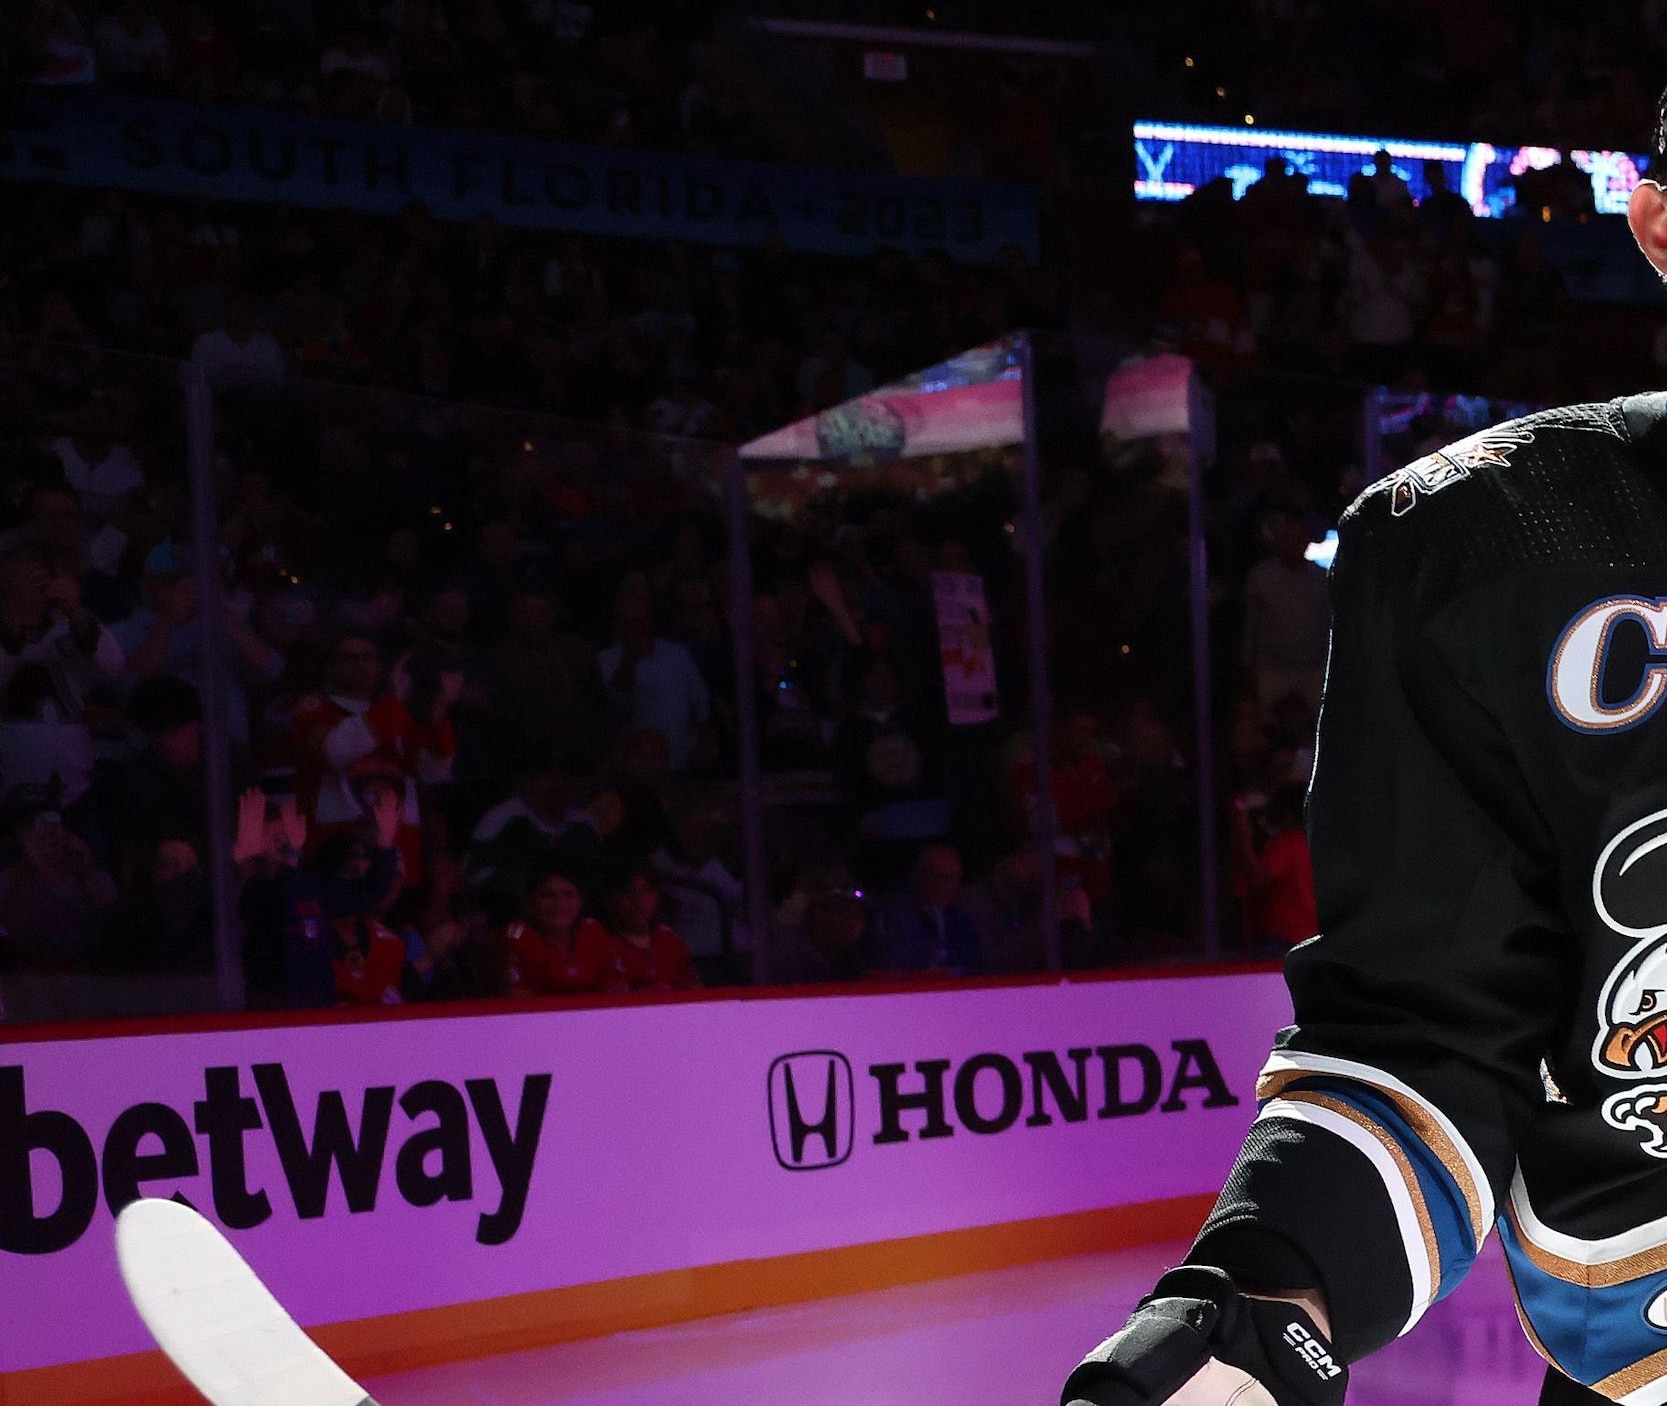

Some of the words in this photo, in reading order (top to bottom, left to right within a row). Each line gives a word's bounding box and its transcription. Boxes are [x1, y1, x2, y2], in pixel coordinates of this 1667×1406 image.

[122, 115, 410, 195] SOUTH
[454, 150, 778, 228] FLORIDA
[838, 190, 985, 243] 2023
[868, 1038, 1240, 1145] HONDA
[0, 1062, 553, 1256] betway
[1286, 1321, 1342, 1378] CCM
[1294, 1346, 1320, 1370] PRO
